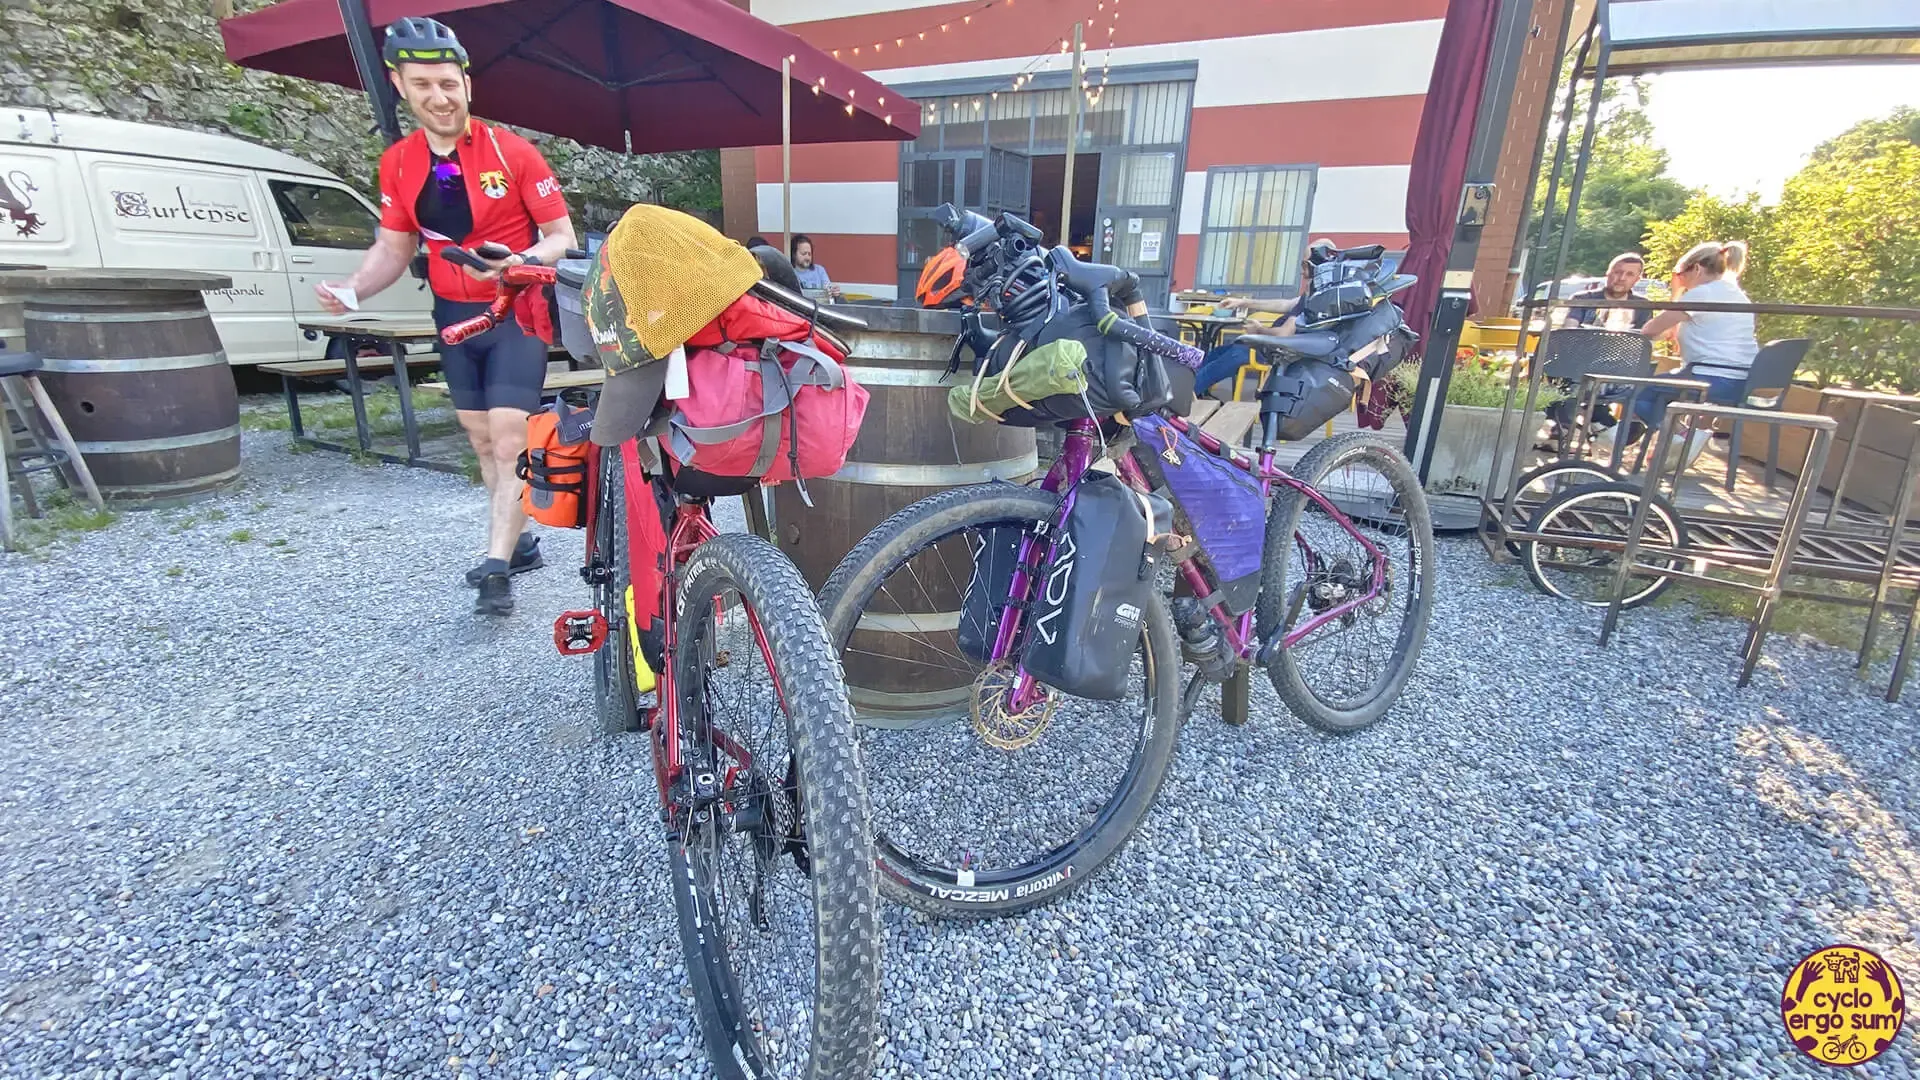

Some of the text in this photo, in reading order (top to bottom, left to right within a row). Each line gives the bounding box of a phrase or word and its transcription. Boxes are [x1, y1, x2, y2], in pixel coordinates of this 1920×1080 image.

[111, 186, 250, 223] Curtense
[683, 559, 707, 594] PATROL
[924, 882, 1010, 903] MEZCAL
